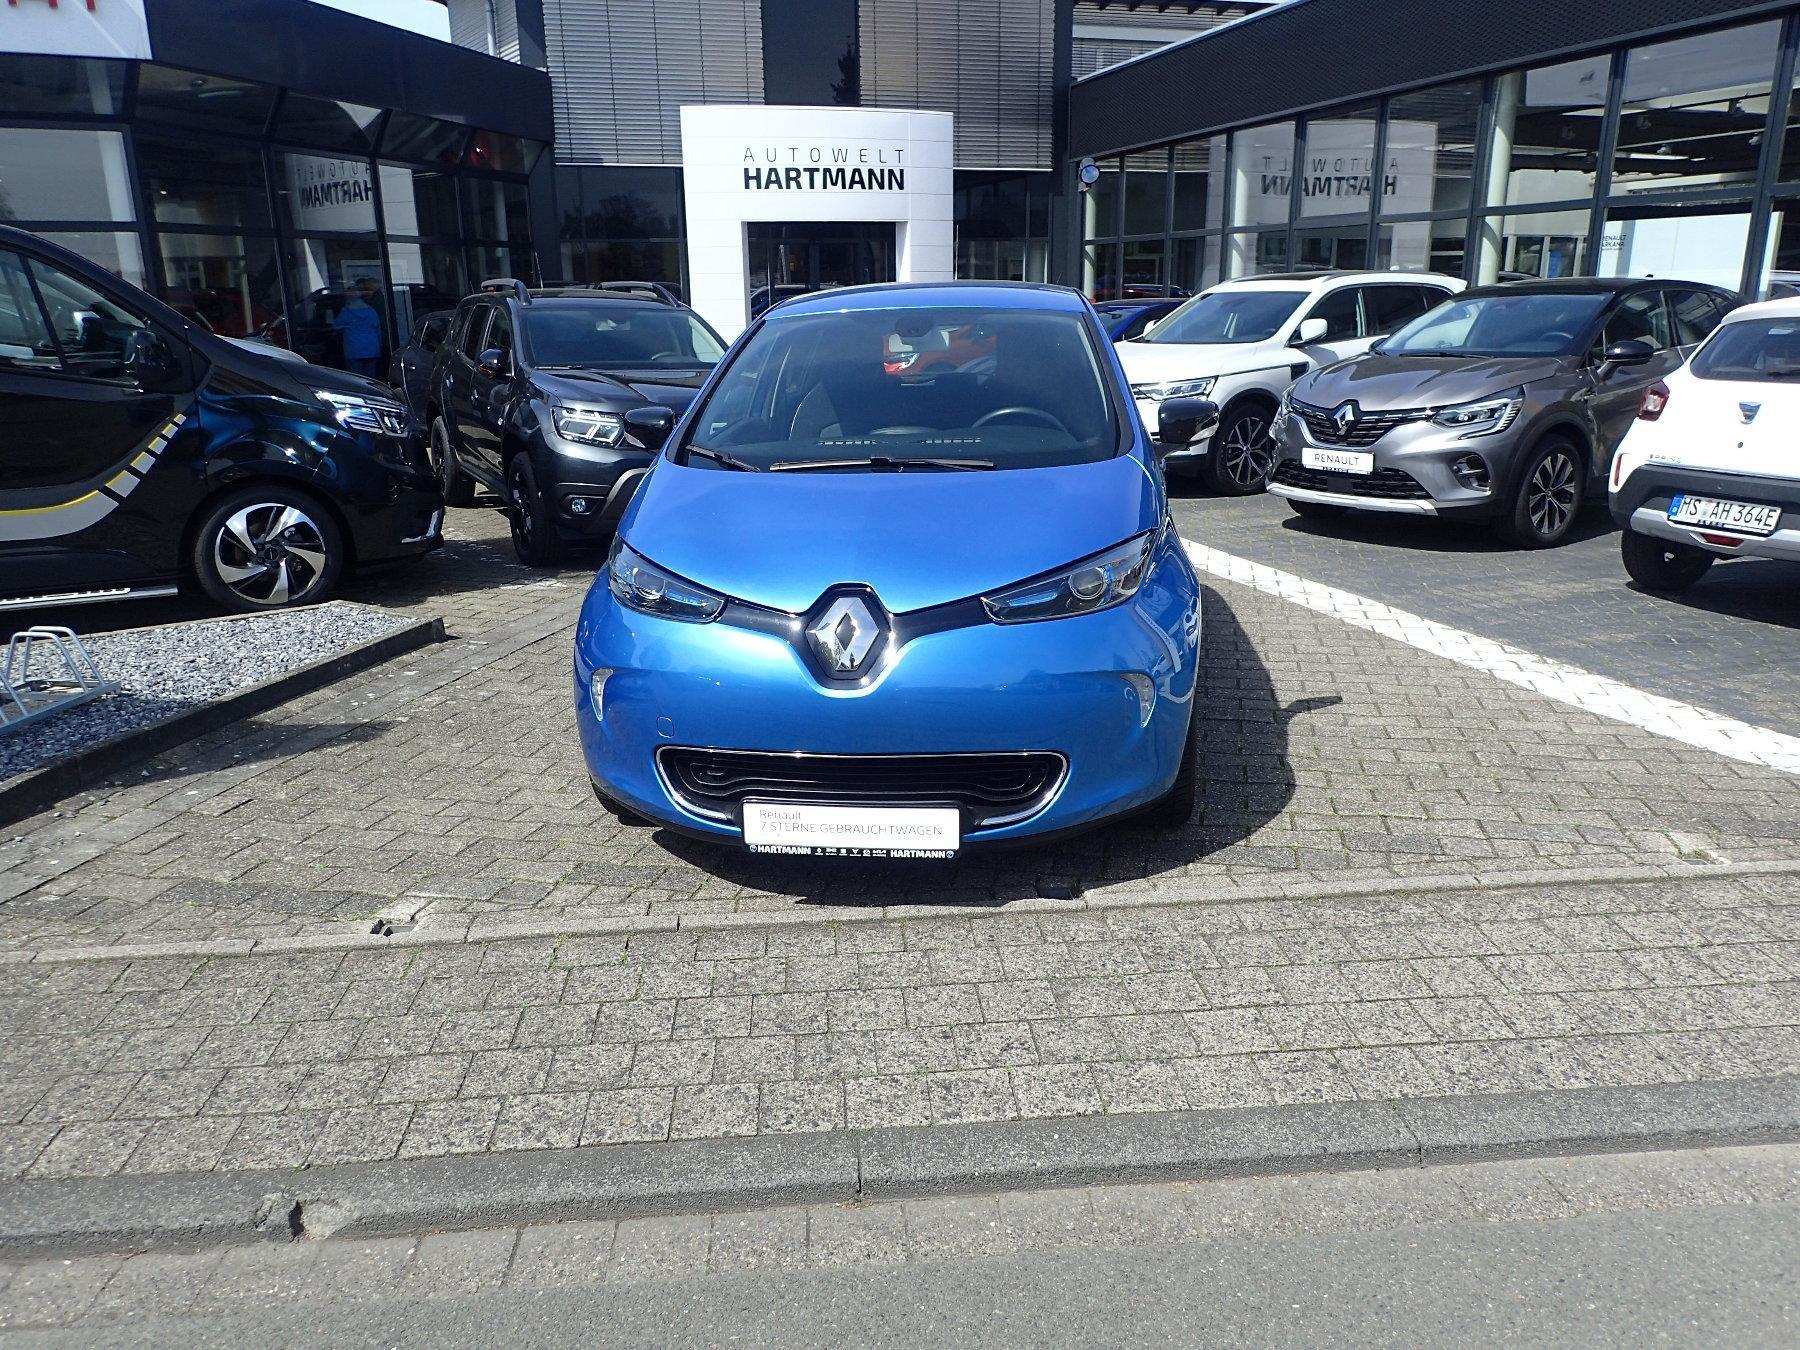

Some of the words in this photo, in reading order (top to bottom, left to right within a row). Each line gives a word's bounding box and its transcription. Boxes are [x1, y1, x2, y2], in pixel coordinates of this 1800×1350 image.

[743, 147, 904, 163] AUTOWELT
[744, 167, 905, 191] HARTMANN
[1314, 453, 1360, 465] RENAULT
[1709, 501, 1732, 520] AH
[1733, 504, 1777, 527] 364E
[759, 809, 801, 821] Renault
[770, 821, 817, 833] STERNE
[820, 823, 943, 836] GEBRAUCHTWAGEN
[757, 845, 811, 855] HARTMANN
[890, 849, 946, 859] HARTMANN
